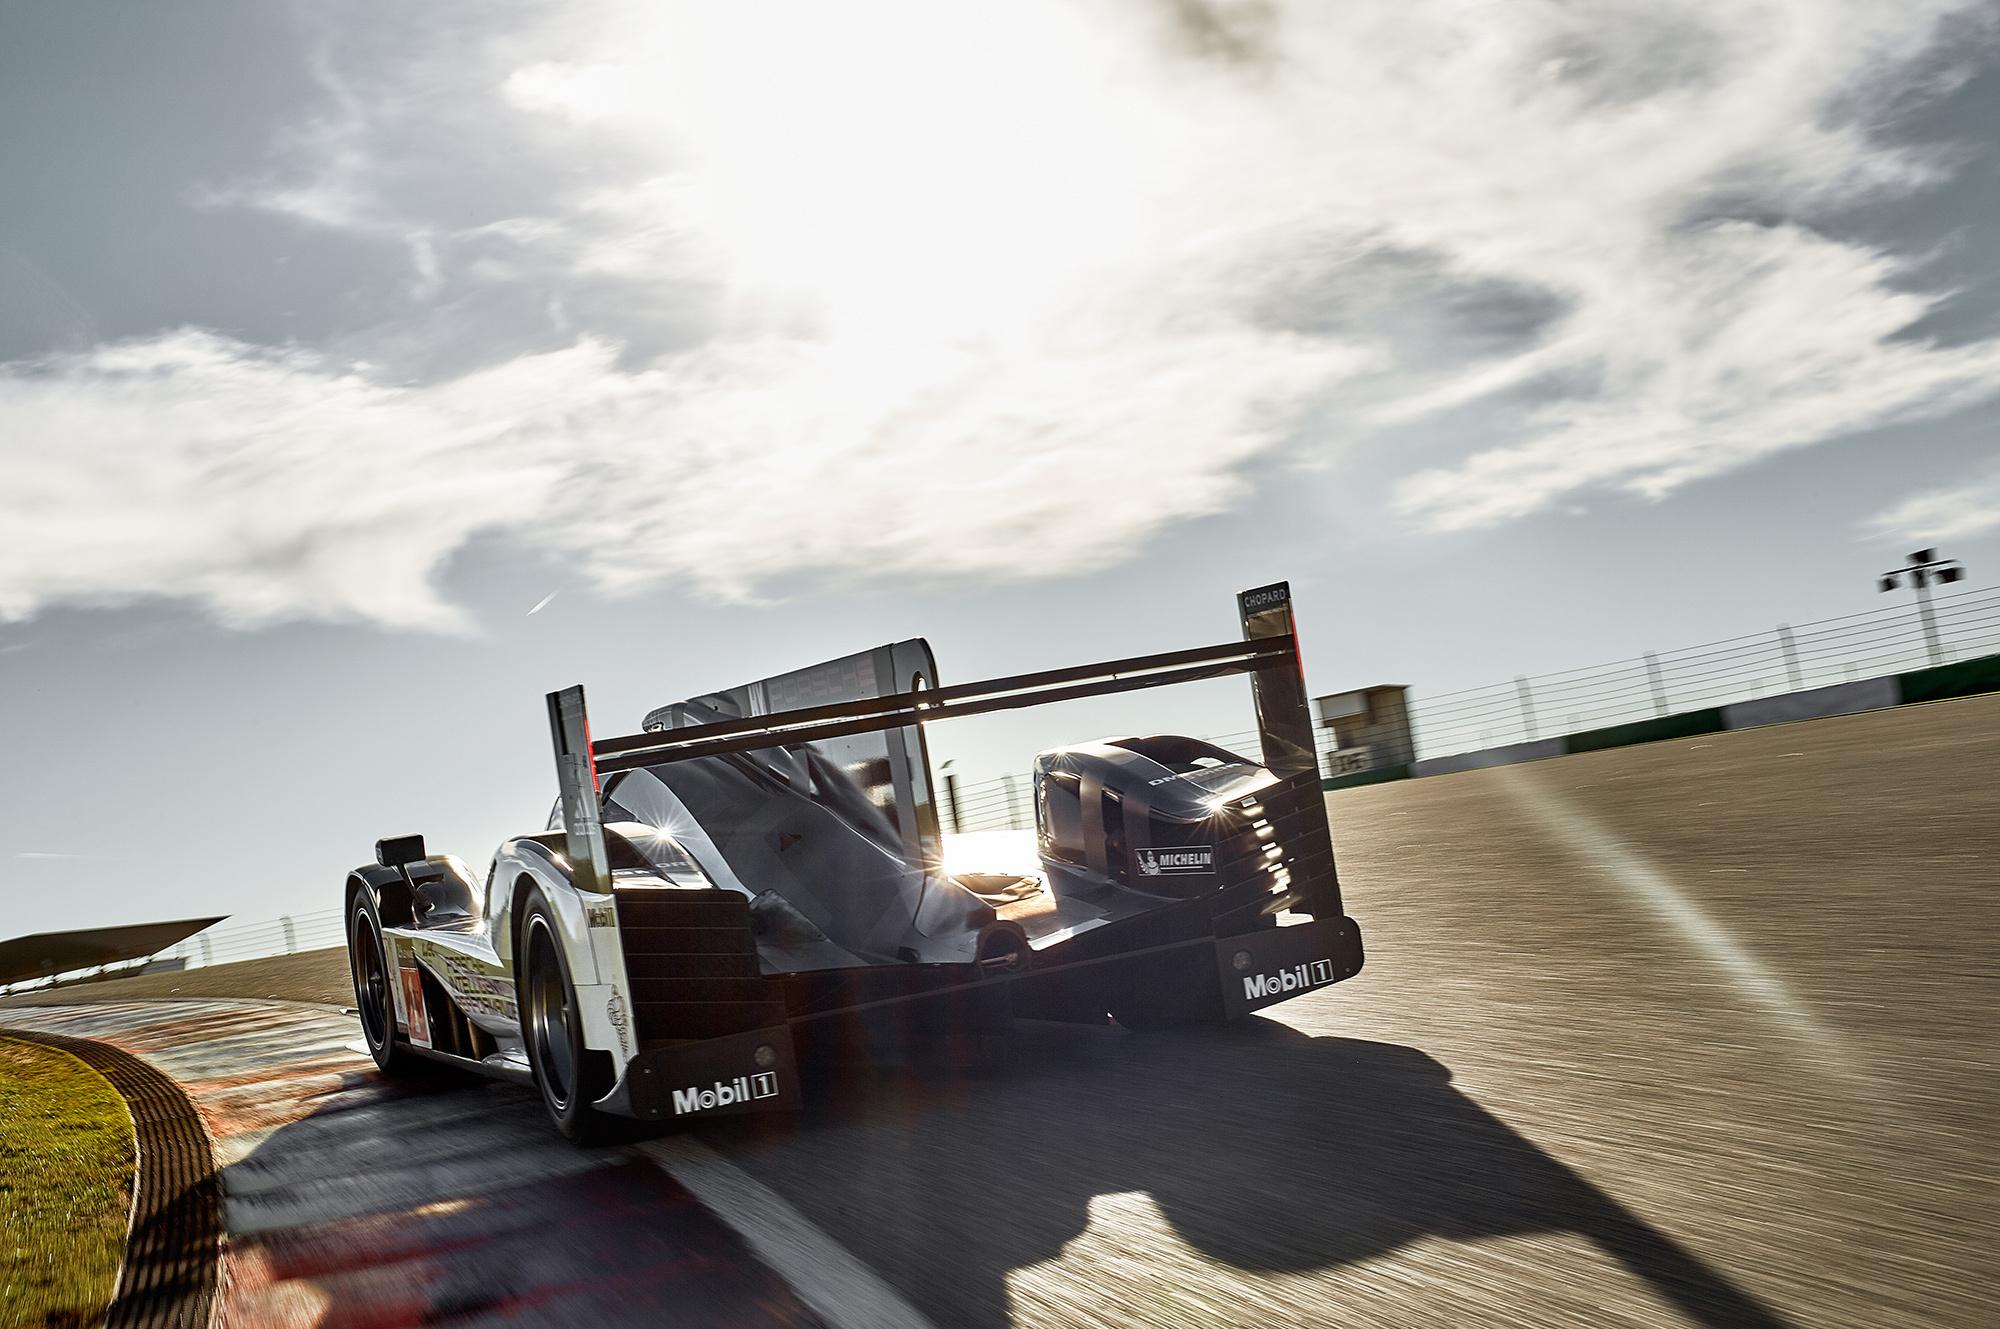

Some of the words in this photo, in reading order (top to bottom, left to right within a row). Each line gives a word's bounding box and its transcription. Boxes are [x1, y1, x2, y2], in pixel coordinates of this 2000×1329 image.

[1244, 589, 1286, 608] CHOPARD
[767, 654, 877, 703] PORSCHE
[1160, 853, 1212, 866] MICHELIN
[1243, 964, 1310, 1000] Mobil
[672, 1077, 751, 1115] Mobil
